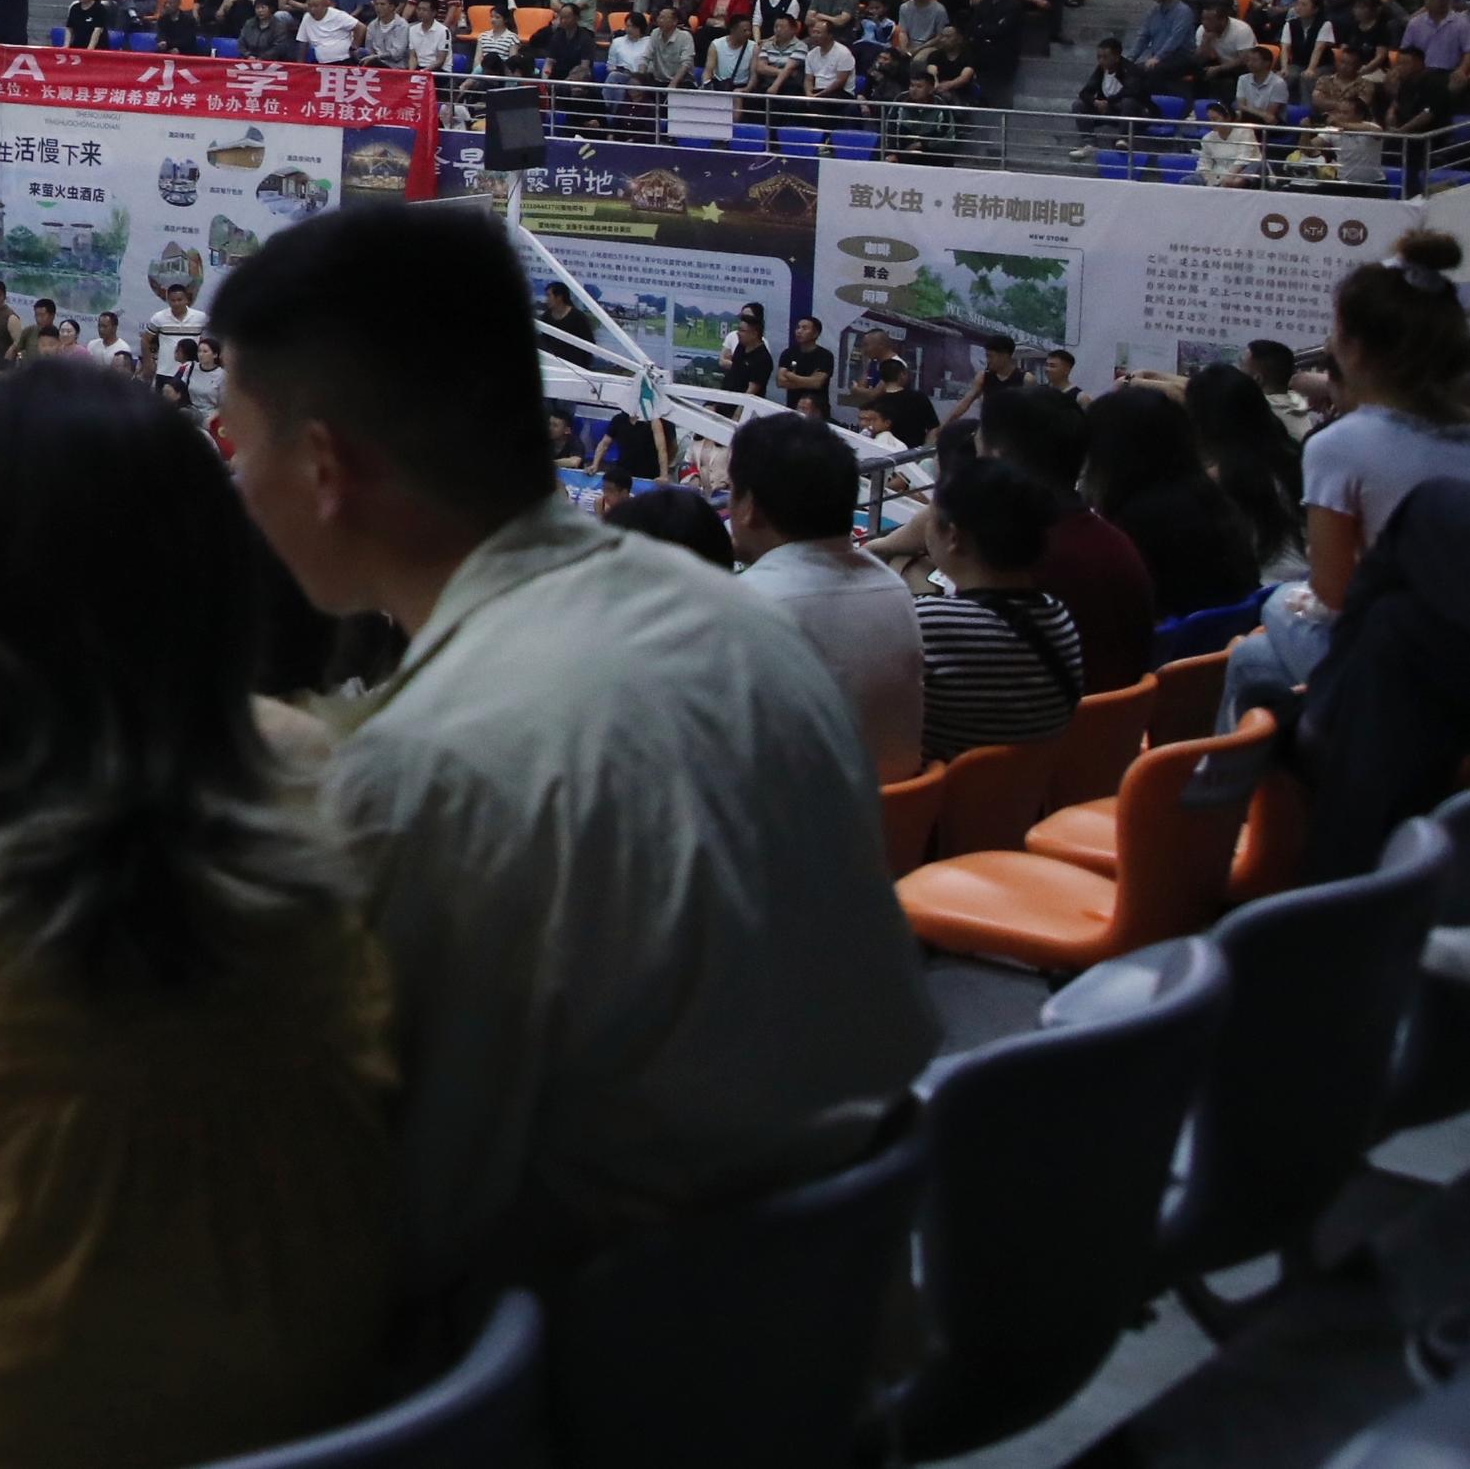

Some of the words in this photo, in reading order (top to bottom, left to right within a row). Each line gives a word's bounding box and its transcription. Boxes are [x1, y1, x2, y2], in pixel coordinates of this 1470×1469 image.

[28, 182, 106, 203] 来萤火虫酒店
[526, 167, 614, 197] 露营地
[863, 265, 890, 280] 聚会
